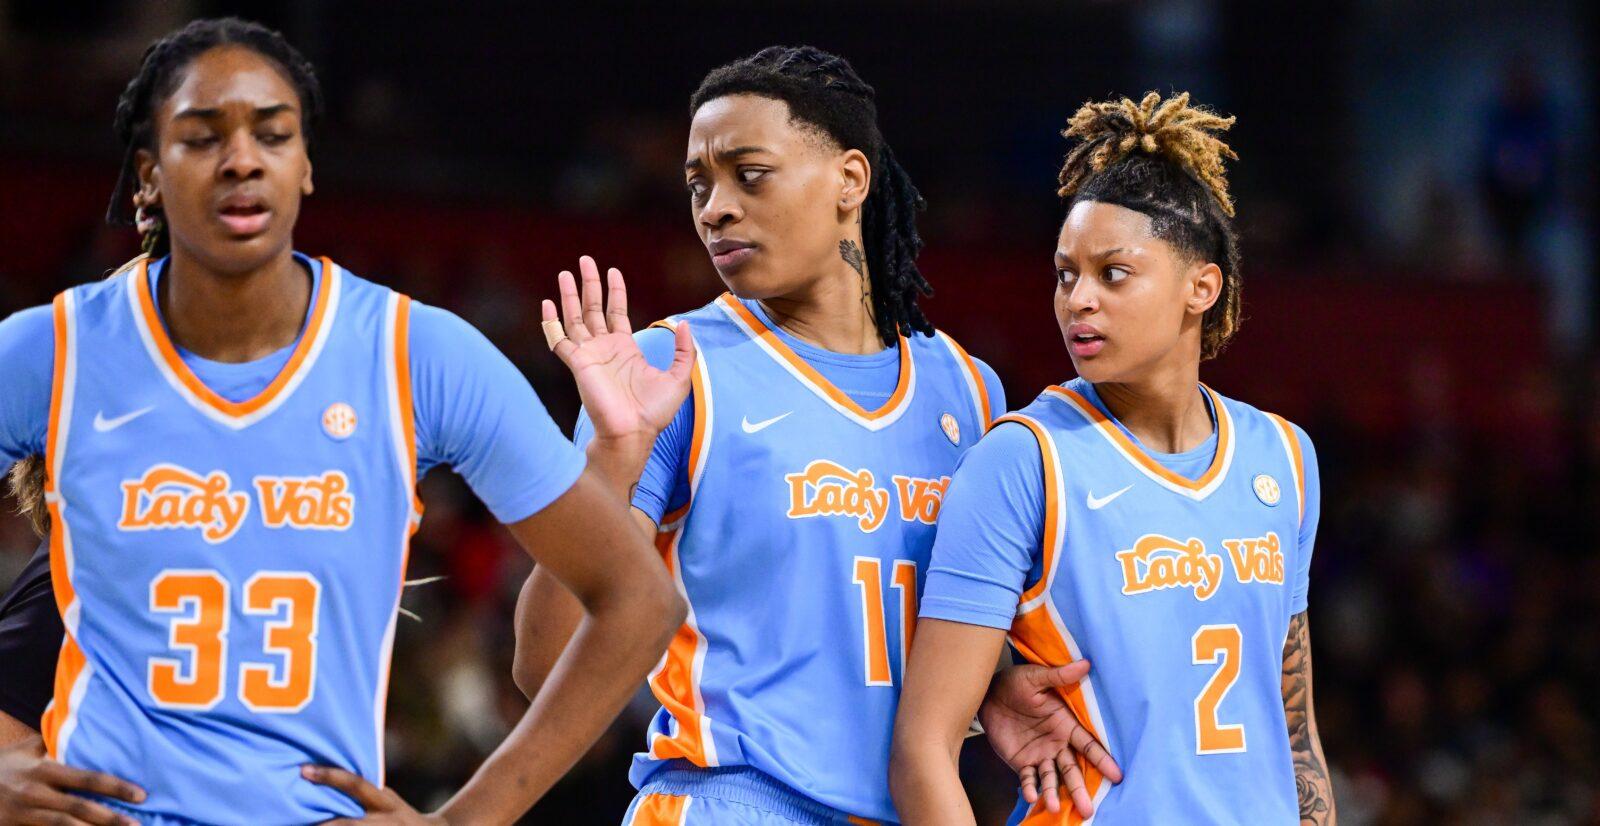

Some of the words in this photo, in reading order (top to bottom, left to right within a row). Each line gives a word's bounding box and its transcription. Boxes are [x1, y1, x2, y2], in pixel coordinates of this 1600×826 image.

[118, 463, 249, 544] Lady
[253, 470, 355, 531] Vols
[786, 460, 889, 533] Lady
[1115, 533, 1223, 601] Lady
[1222, 531, 1284, 585] Vols
[147, 568, 322, 713] 33
[1191, 624, 1247, 756] 2
